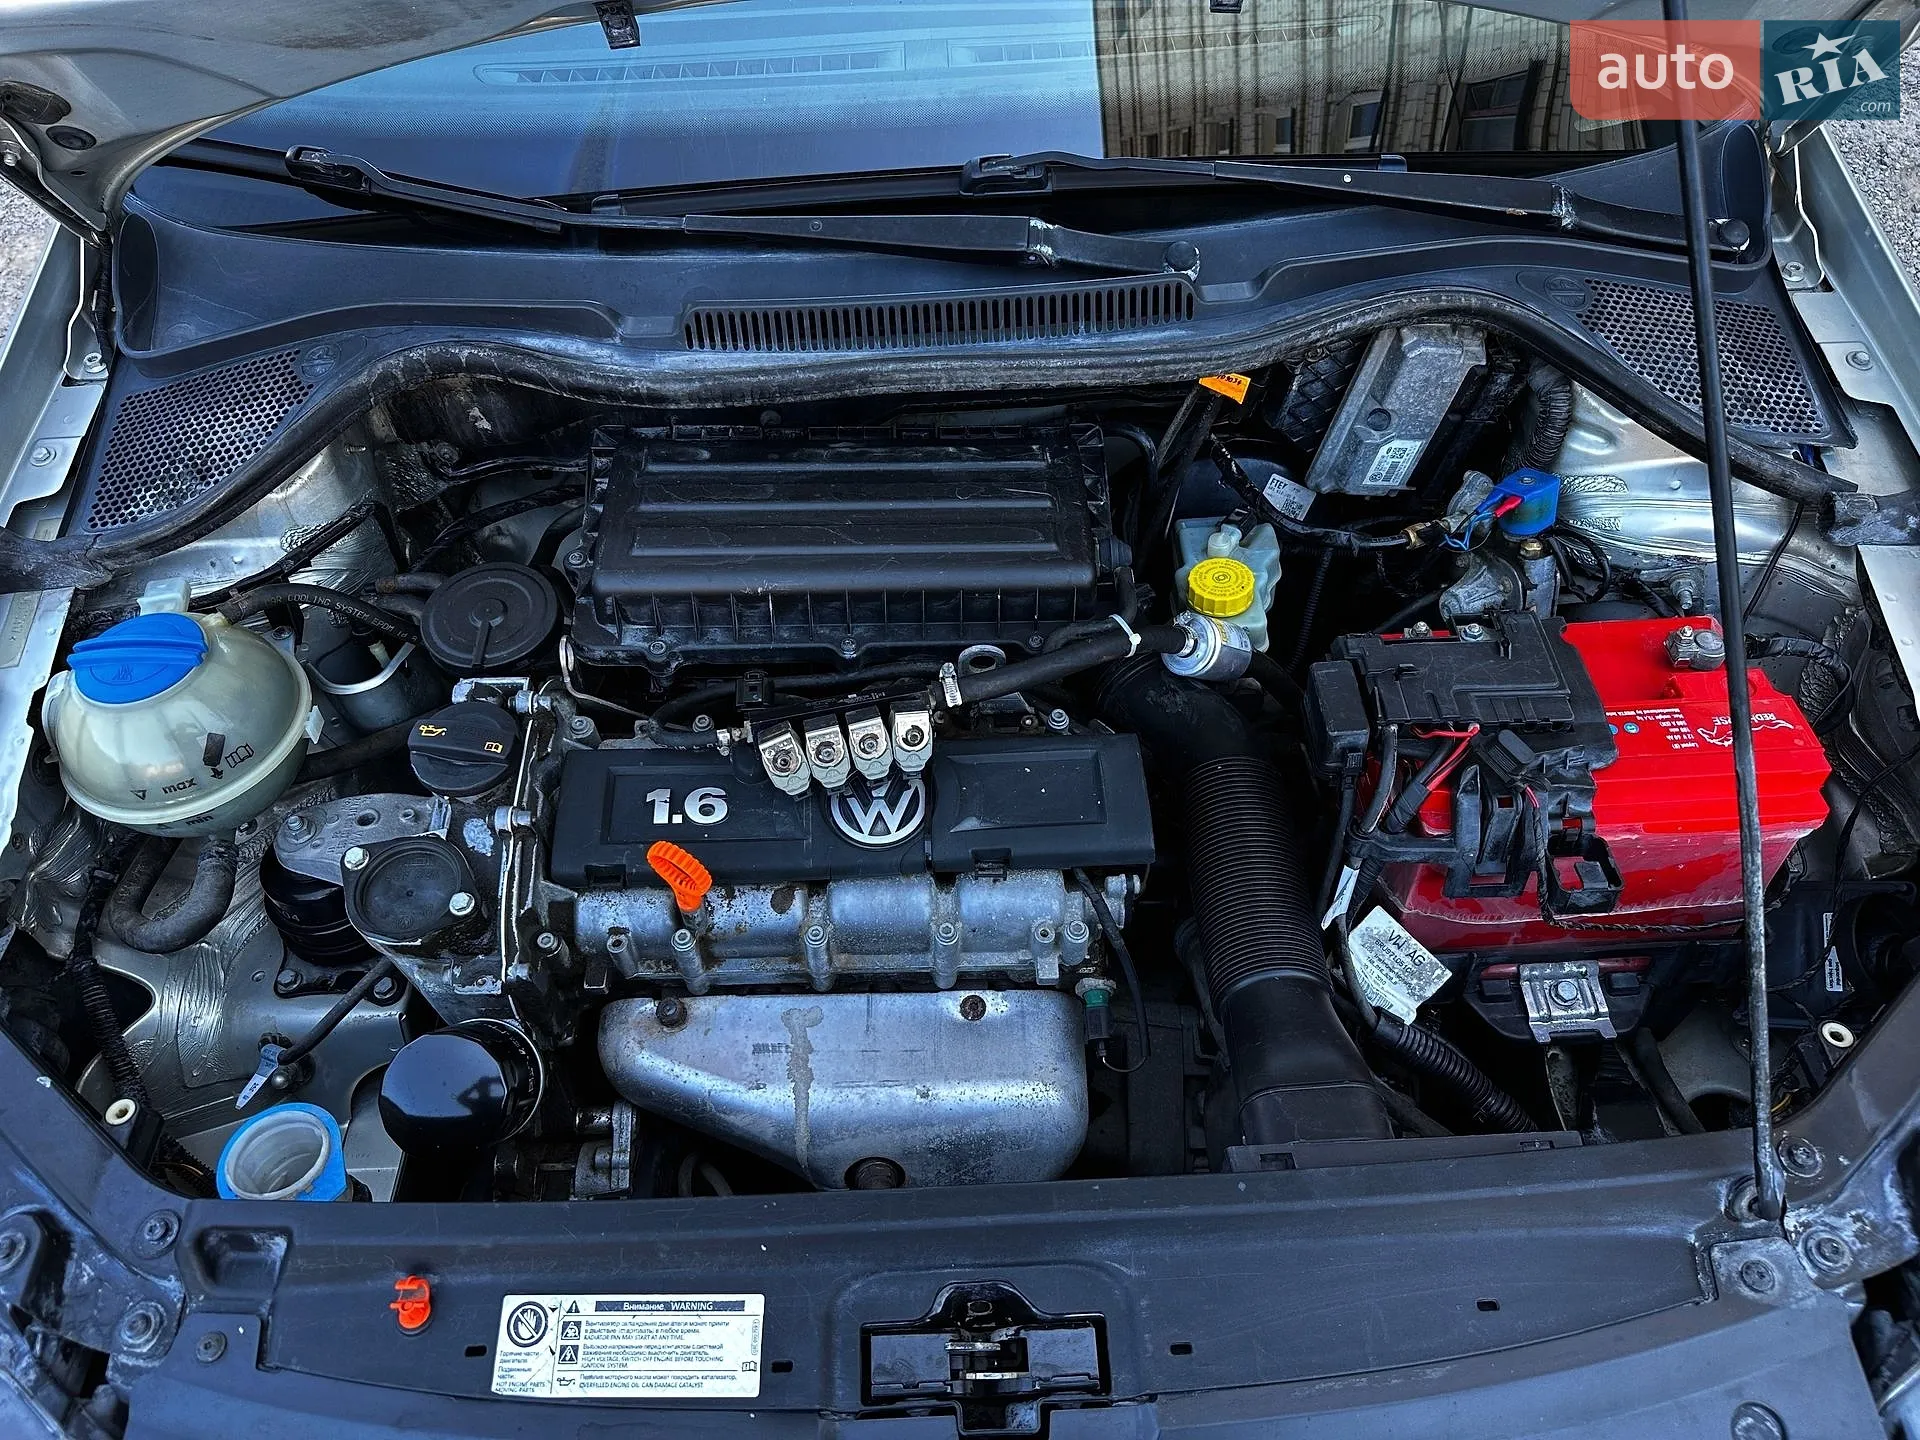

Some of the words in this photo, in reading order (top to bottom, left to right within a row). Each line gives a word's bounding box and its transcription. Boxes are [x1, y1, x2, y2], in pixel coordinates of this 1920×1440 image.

[287, 594, 331, 606] COOLING
[335, 602, 370, 621] SYSTEM
[371, 618, 395, 634] EPDM
[161, 777, 198, 795] max
[646, 787, 728, 825] 1.6
[185, 813, 215, 827] min
[1388, 930, 1406, 950] VW
[1405, 949, 1426, 967] AG
[623, 1302, 665, 1310] Внимание
[670, 1302, 713, 1311] WARNING
